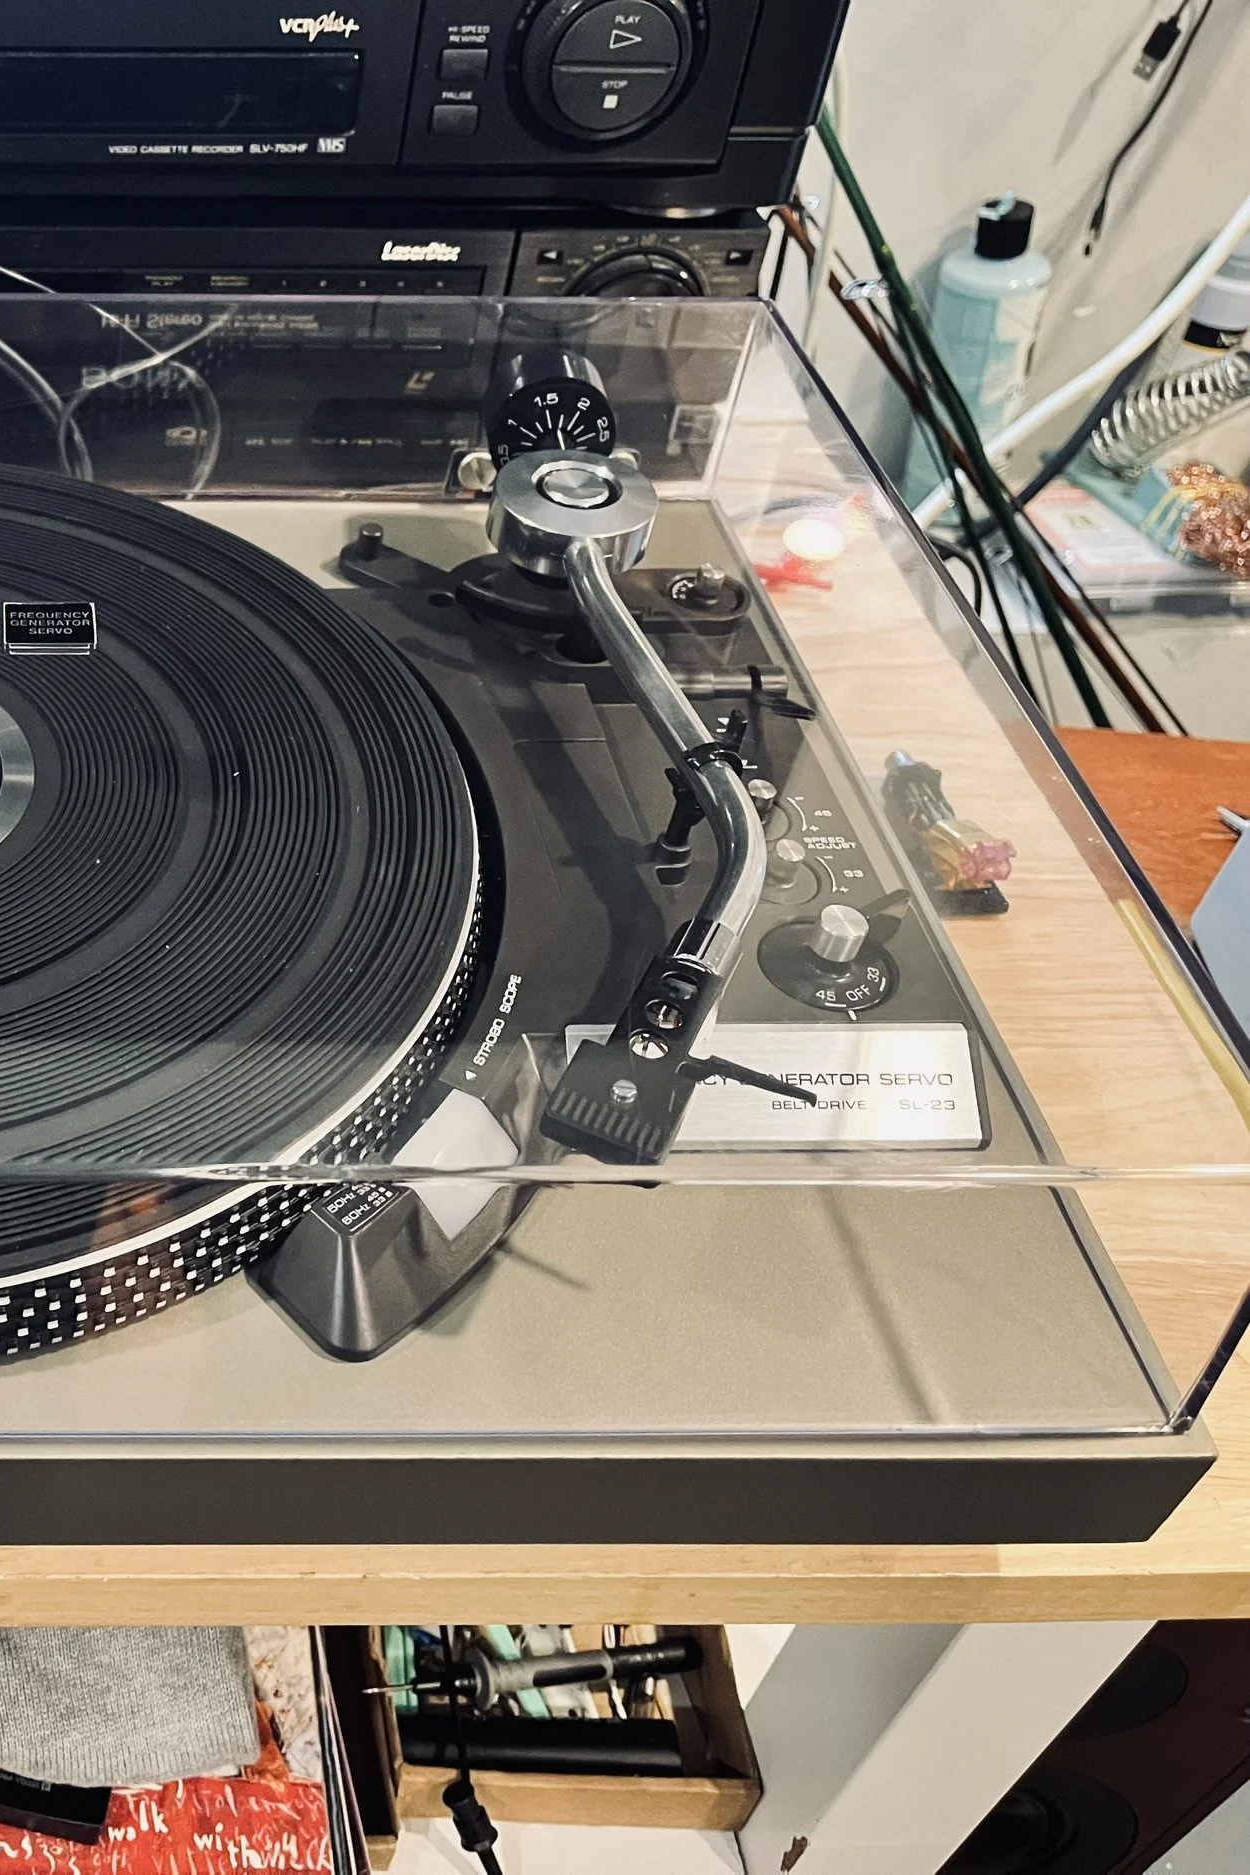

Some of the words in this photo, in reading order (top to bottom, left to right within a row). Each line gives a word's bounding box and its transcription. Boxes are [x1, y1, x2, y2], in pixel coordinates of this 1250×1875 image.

[615, 15, 641, 24] PLAY
[450, 35, 486, 43] REWIND
[602, 80, 628, 89] STOP
[442, 91, 472, 100] PAUSE
[108, 145, 137, 153] VIDEO
[140, 145, 188, 153] CASSETTE
[191, 145, 243, 153] RECORDER
[381, 241, 461, 261] LaserDisc
[534, 393, 559, 407] 1.5
[577, 397, 590, 411] 2
[10, 611, 90, 619] FREQUENCY
[29, 627, 73, 635] SERVO
[866, 966, 879, 983] 33
[815, 989, 836, 1001] 45
[845, 984, 870, 1001] OFF
[472, 1018, 506, 1066] STROBO
[499, 974, 522, 1014] SCOPE
[879, 1074, 954, 1086] SERVO
[817, 1100, 867, 1110] DRIVE
[899, 1100, 956, 1110] SL-23
[108, 1800, 169, 1842] walk
